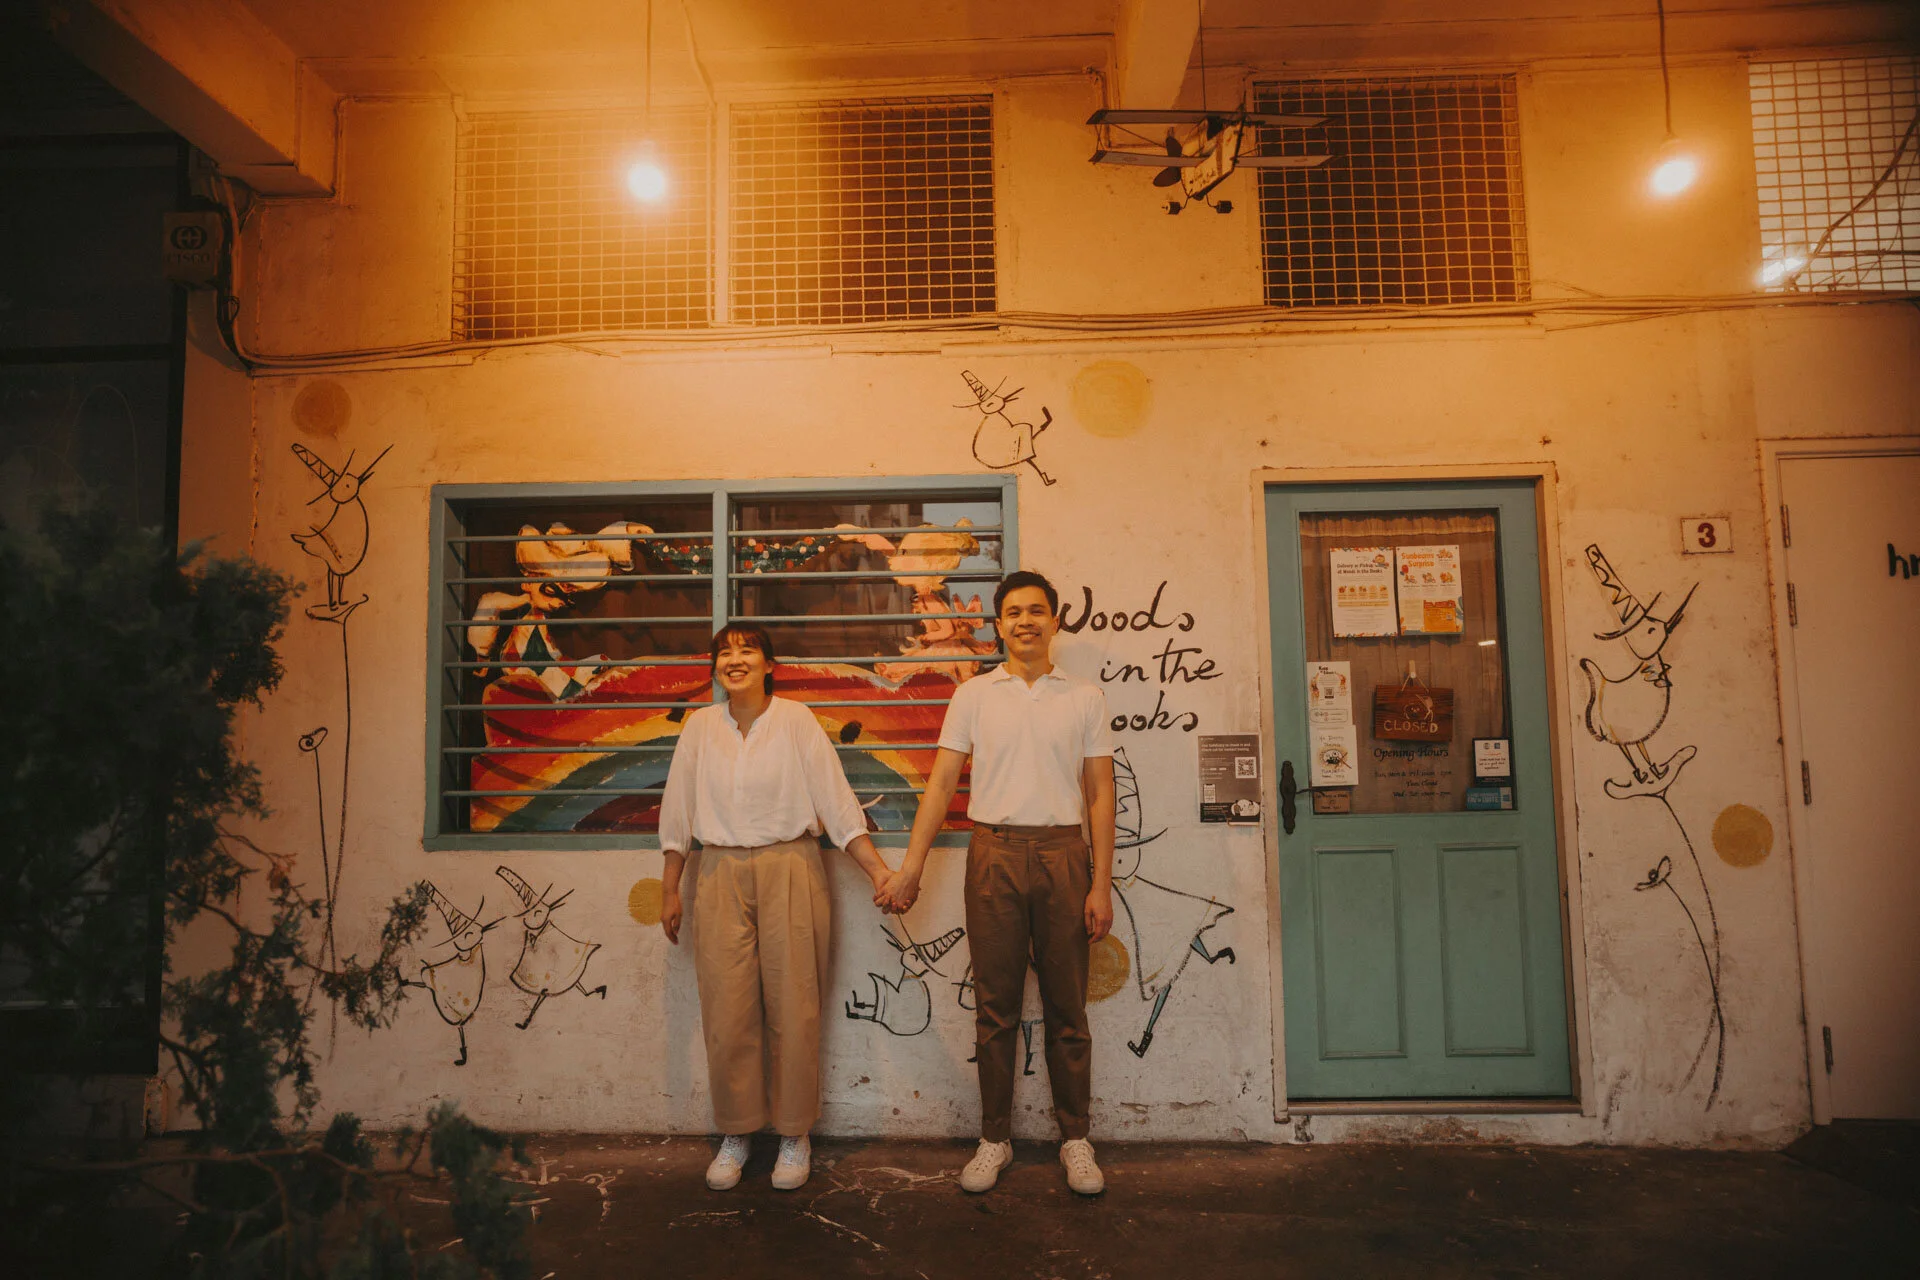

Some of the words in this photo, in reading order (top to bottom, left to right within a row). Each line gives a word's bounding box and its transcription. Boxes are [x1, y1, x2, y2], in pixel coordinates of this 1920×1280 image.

[1697, 522, 1717, 548] 3
[1408, 560, 1435, 569] Surprise
[1100, 660, 1149, 683] in
[1152, 638, 1223, 684] the
[1110, 690, 1199, 733] ooks
[1383, 719, 1439, 734] CLOSED
[1374, 747, 1415, 762] Opening
[1417, 746, 1449, 758] Hours
